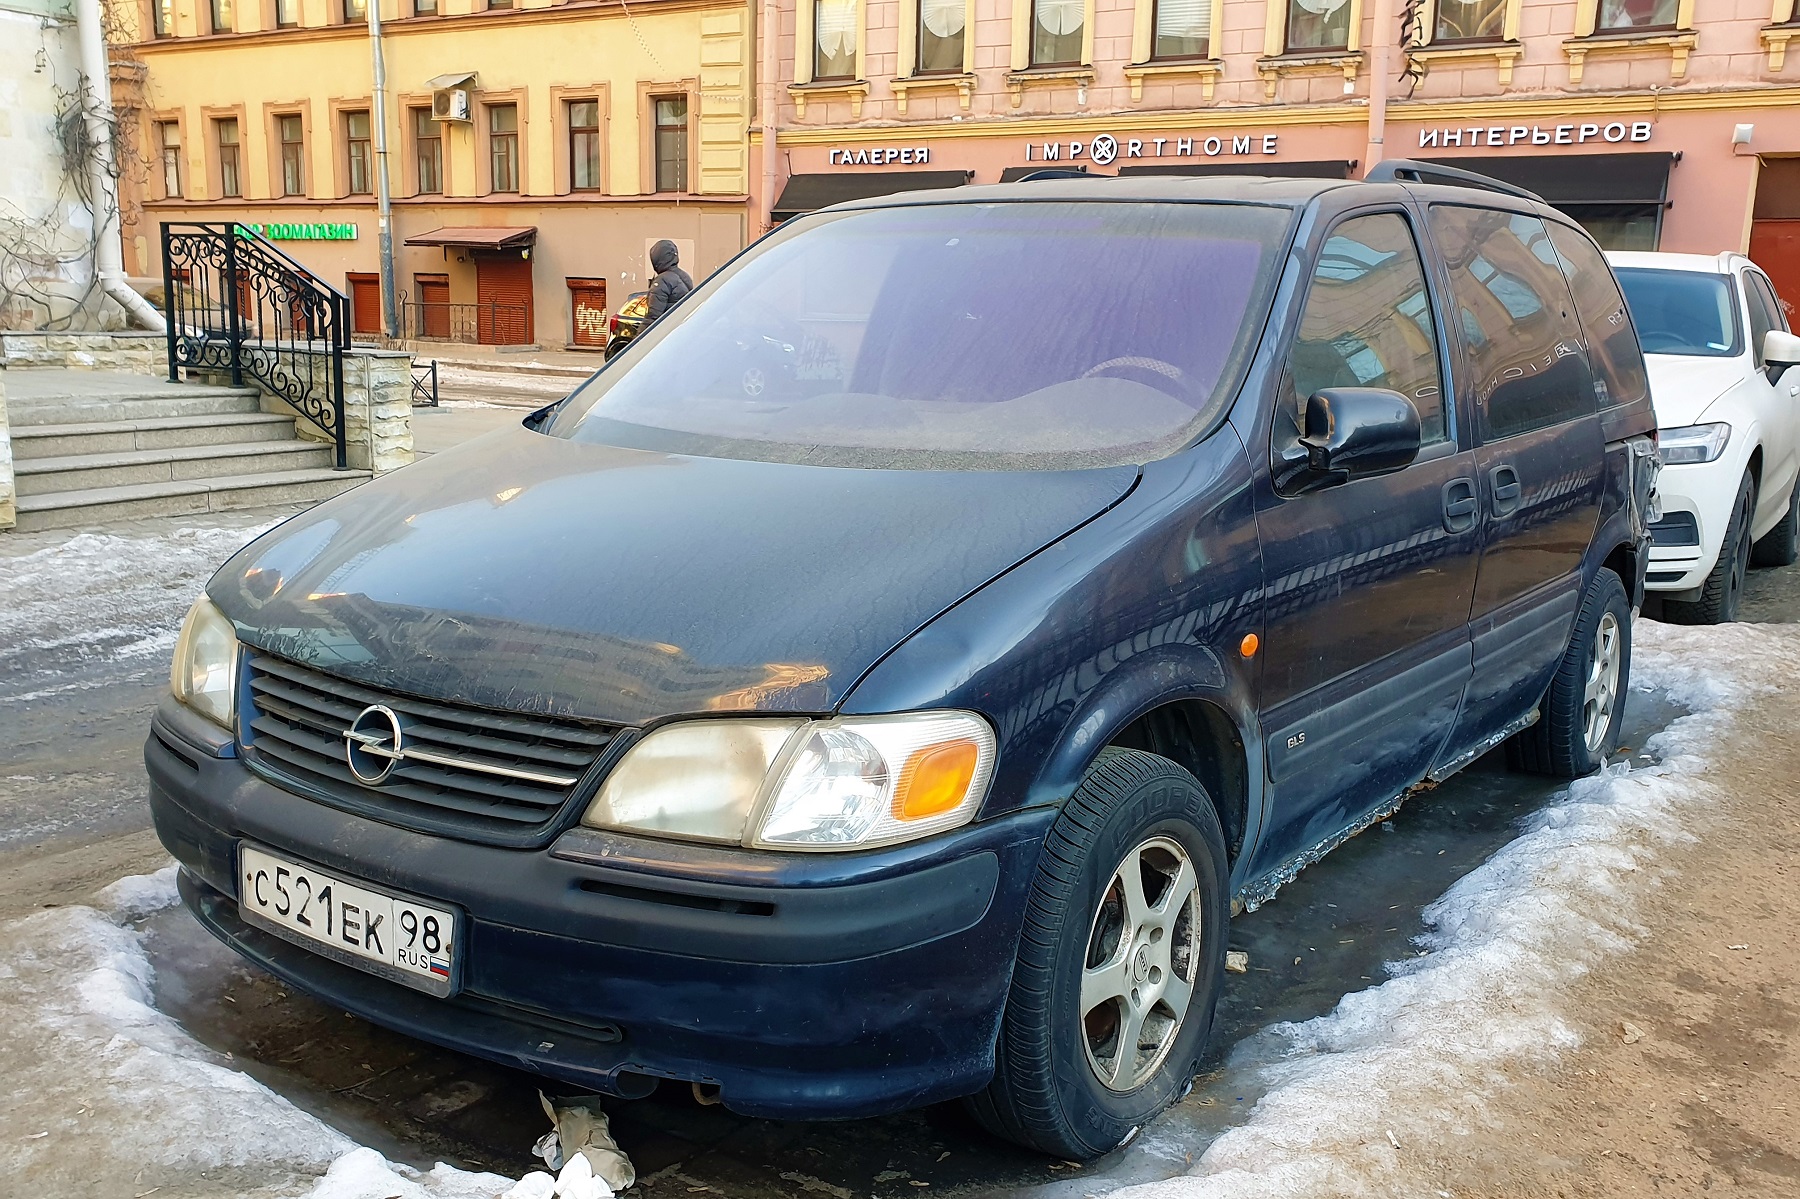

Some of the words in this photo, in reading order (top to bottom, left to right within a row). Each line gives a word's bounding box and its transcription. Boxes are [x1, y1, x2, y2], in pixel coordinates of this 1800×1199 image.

[1419, 122, 1652, 148] ИНТЕРЬЕРОВ
[829, 147, 929, 165] ГАЛЕРЕЯ
[266, 223, 358, 239] ЗООМАГАЗИН
[400, 909, 441, 954] 98
[399, 949, 428, 970] RUS
